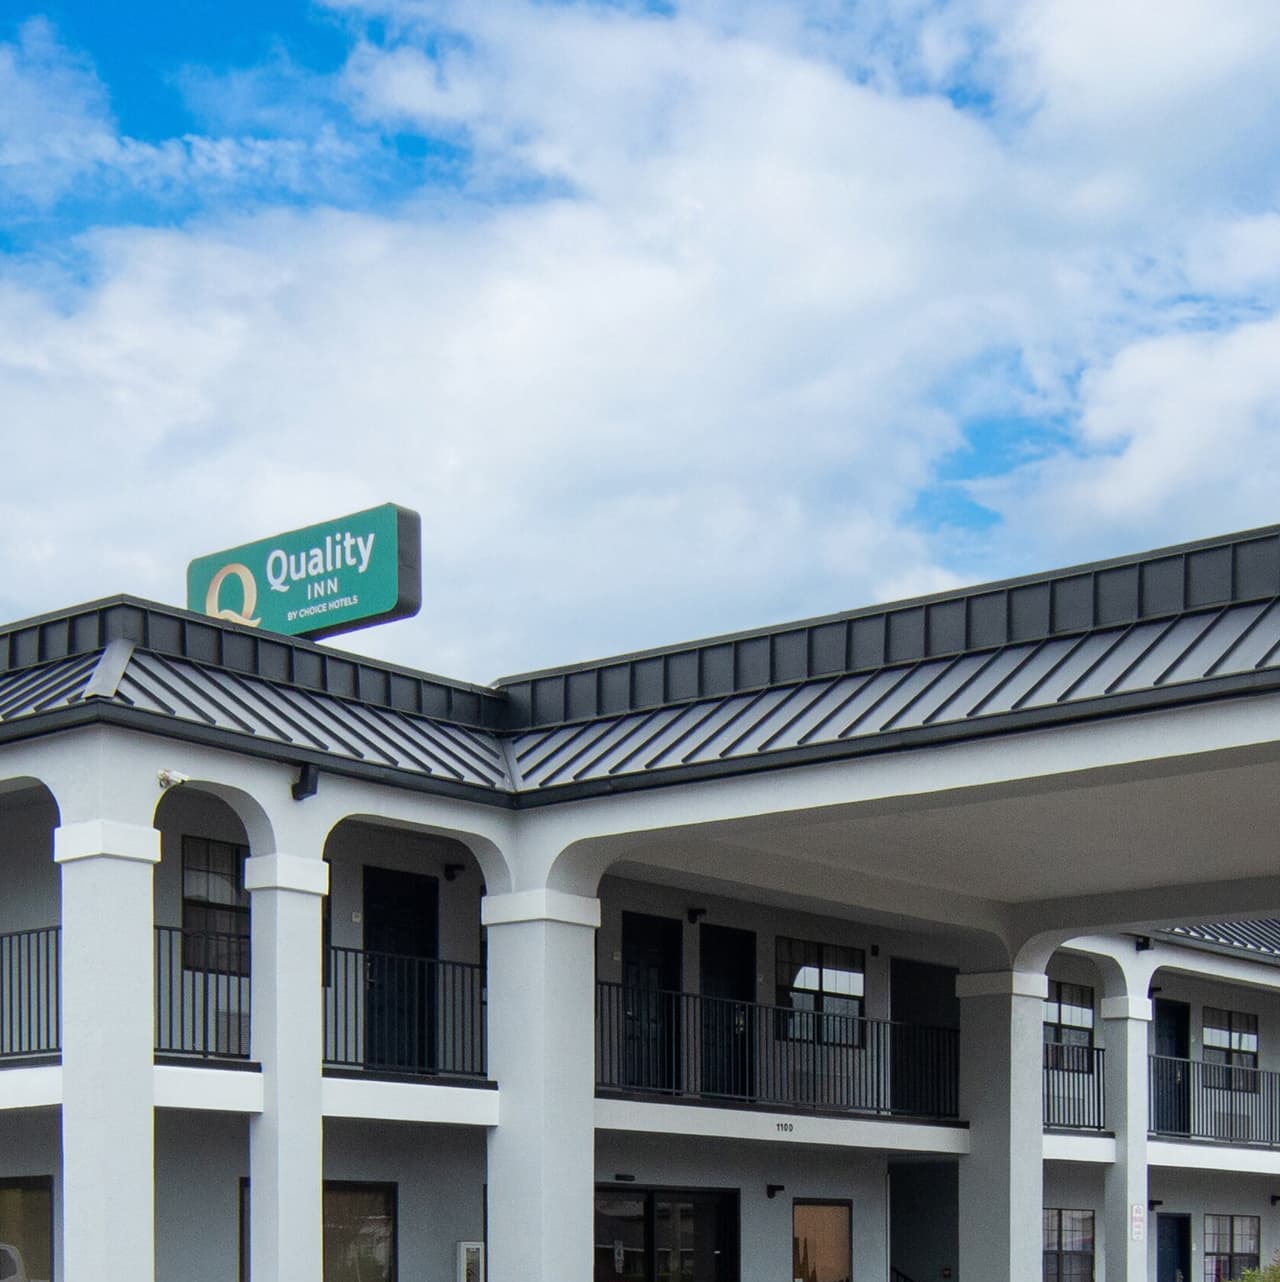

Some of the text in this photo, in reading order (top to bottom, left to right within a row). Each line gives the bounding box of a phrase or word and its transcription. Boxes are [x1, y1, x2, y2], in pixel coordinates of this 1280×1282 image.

[266, 532, 375, 592] Quality
[206, 563, 262, 628] Q
[307, 577, 338, 600] INN
[287, 595, 359, 621] BY CHOICE HOTELS
[776, 1122, 794, 1133] 1100
